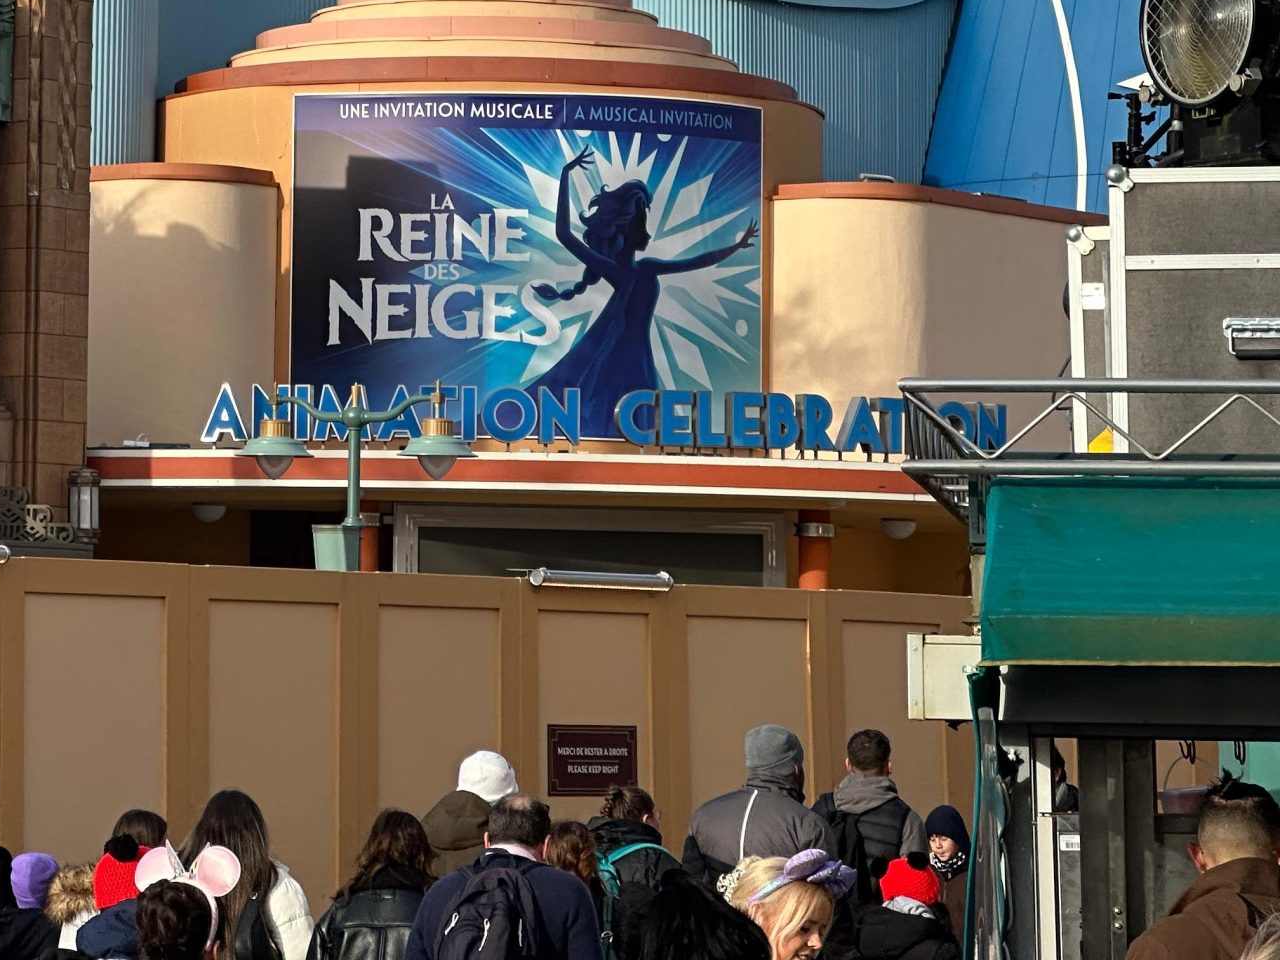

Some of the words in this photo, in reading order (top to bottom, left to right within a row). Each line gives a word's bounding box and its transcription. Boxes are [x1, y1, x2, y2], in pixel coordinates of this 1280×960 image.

[340, 103, 369, 119] UNE
[374, 102, 465, 118] INVITATION
[470, 103, 553, 120] MUSICALE
[574, 108, 586, 121] A
[589, 107, 657, 124] MUSICAL
[660, 110, 733, 129] INVITATION
[430, 193, 455, 210] LA
[357, 208, 531, 262] REINE
[423, 263, 461, 281] DES
[326, 277, 562, 346] NEIGES
[200, 382, 581, 446] ANIMATION
[614, 389, 1008, 454] CELEBRATON
[557, 747, 576, 756] MERCI
[576, 747, 584, 756] DE
[584, 747, 603, 756] RESTER
[609, 748, 628, 756] DROITE
[567, 765, 588, 774] PLEASE
[588, 765, 602, 774] KEEP
[602, 765, 619, 774] RIGHT
